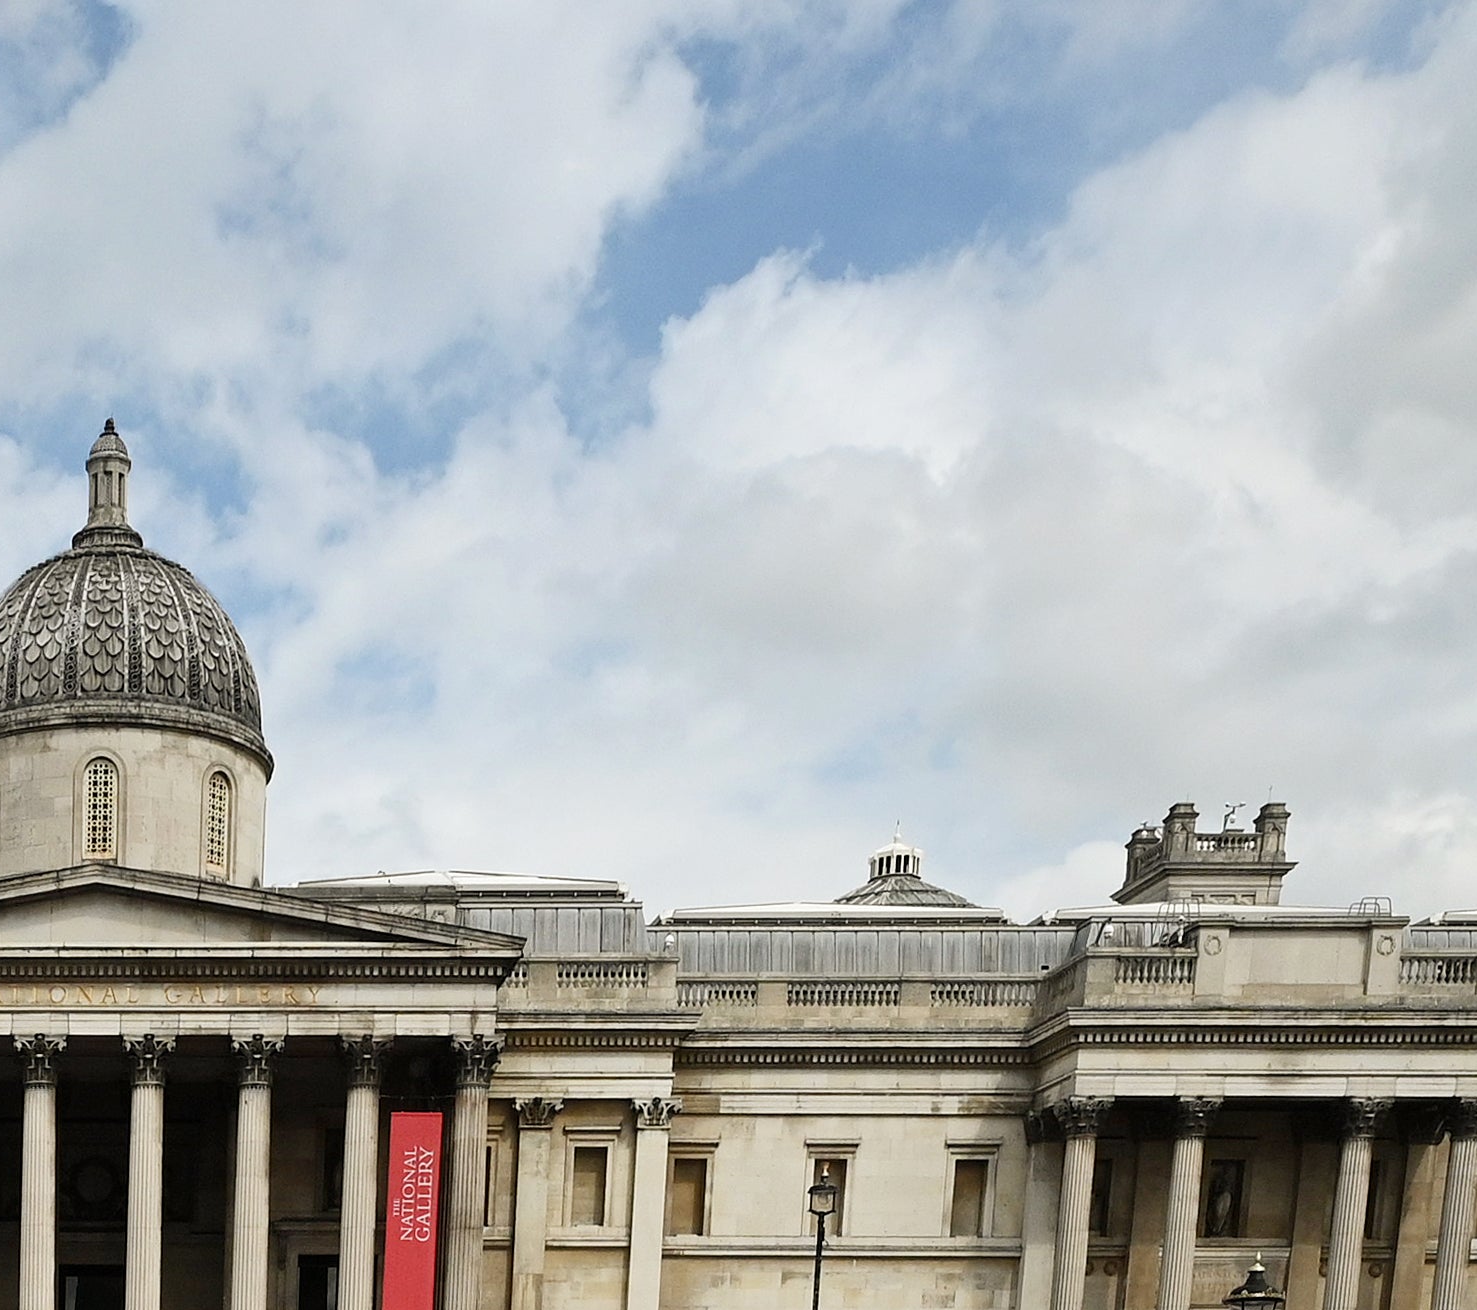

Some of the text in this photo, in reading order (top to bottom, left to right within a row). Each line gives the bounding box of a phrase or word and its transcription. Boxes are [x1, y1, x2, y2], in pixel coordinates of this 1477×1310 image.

[163, 985, 322, 1005] GALLERY
[400, 1145, 418, 1242] NATIONAL
[414, 1146, 435, 1242] GALLERY
